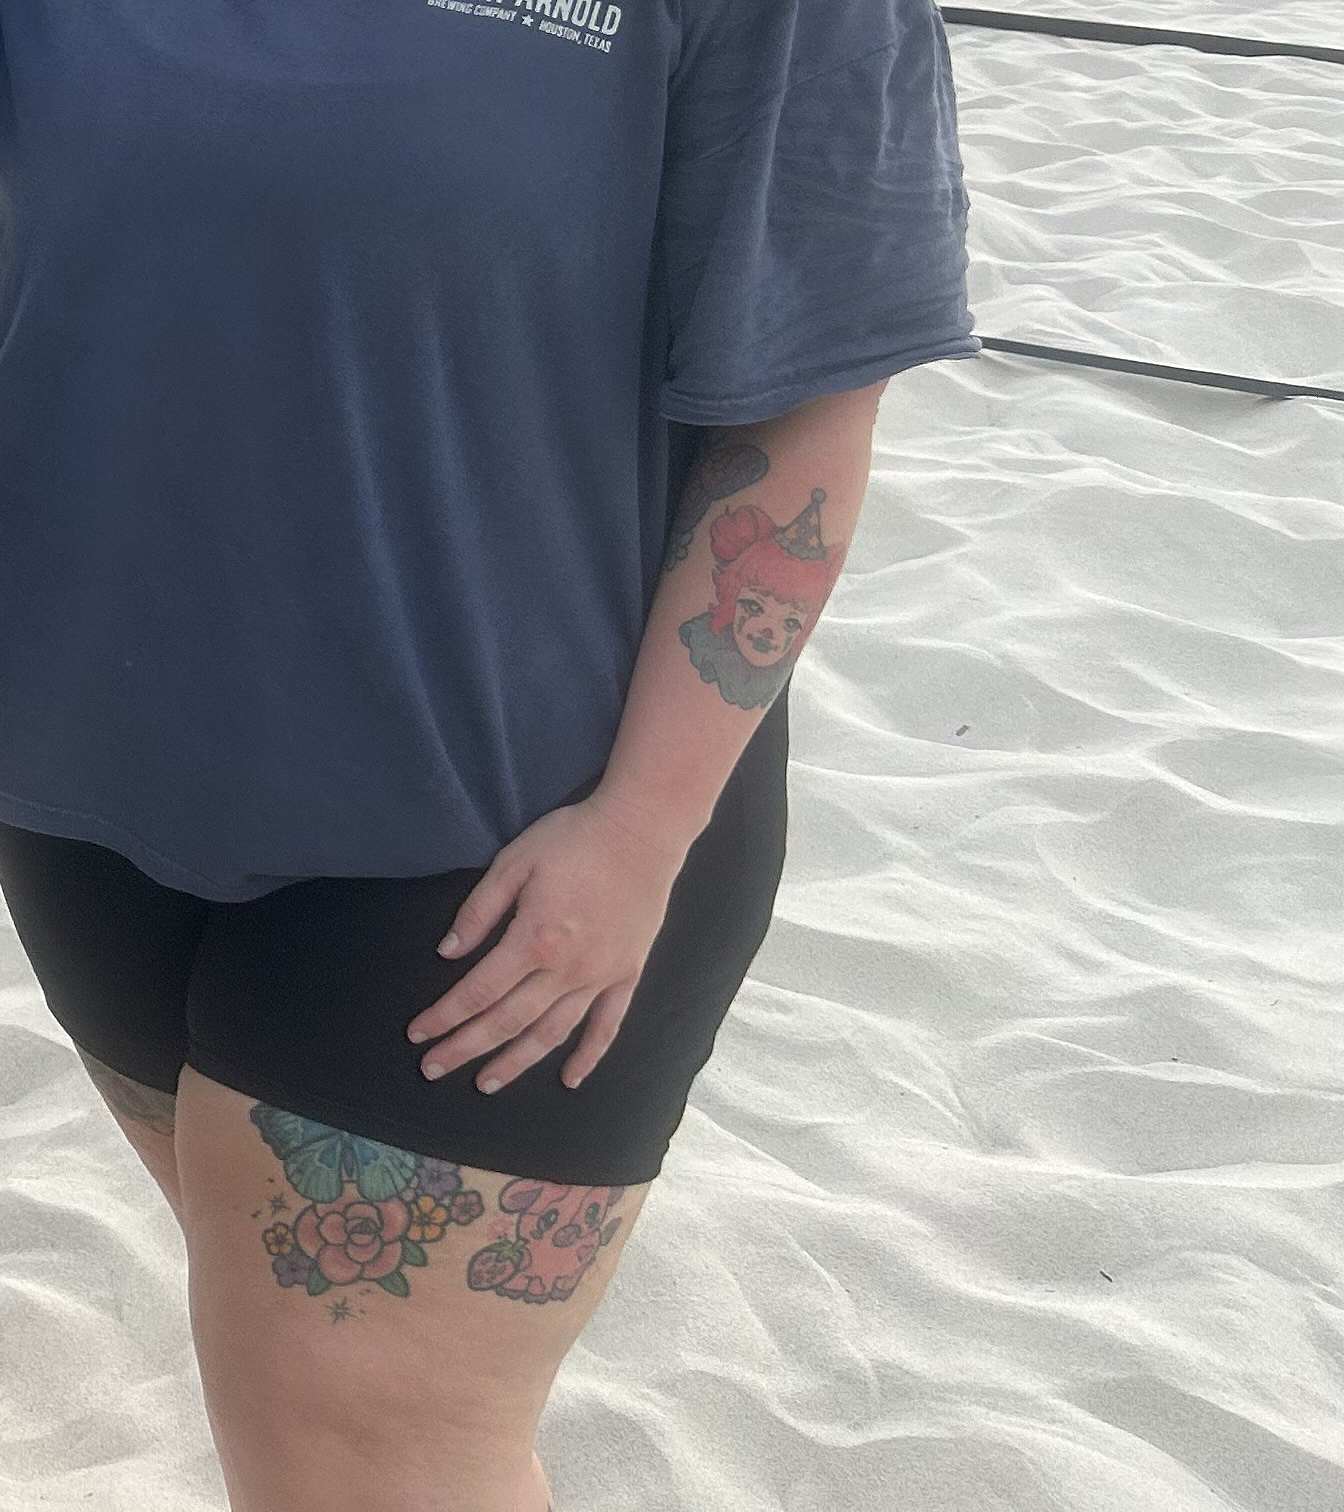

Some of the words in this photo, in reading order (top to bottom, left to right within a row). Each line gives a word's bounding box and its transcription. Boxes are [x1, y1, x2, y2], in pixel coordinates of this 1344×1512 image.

[473, 4, 518, 22] COMPANY
[538, 19, 582, 45] HOUSTON,
[583, 33, 612, 54] TEXAS
